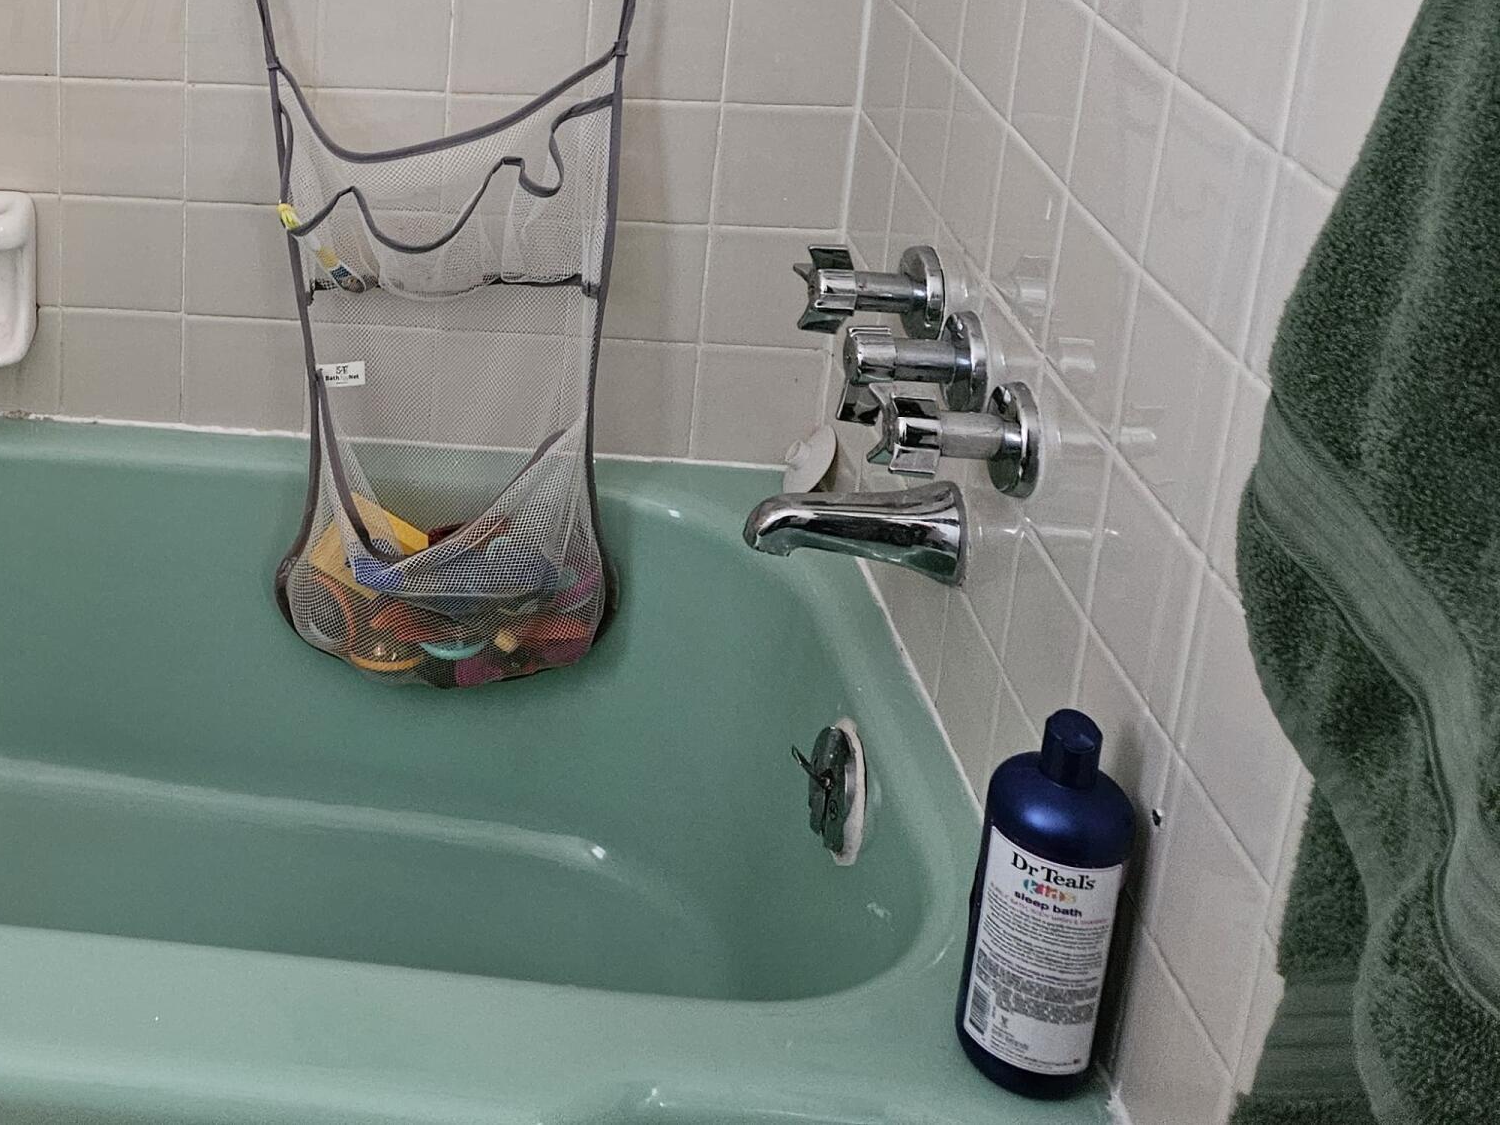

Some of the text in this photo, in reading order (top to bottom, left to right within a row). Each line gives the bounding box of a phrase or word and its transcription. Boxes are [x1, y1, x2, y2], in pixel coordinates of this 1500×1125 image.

[1010, 851, 1096, 890] Dr Teal's
[1014, 890, 1083, 918] sleep bath
